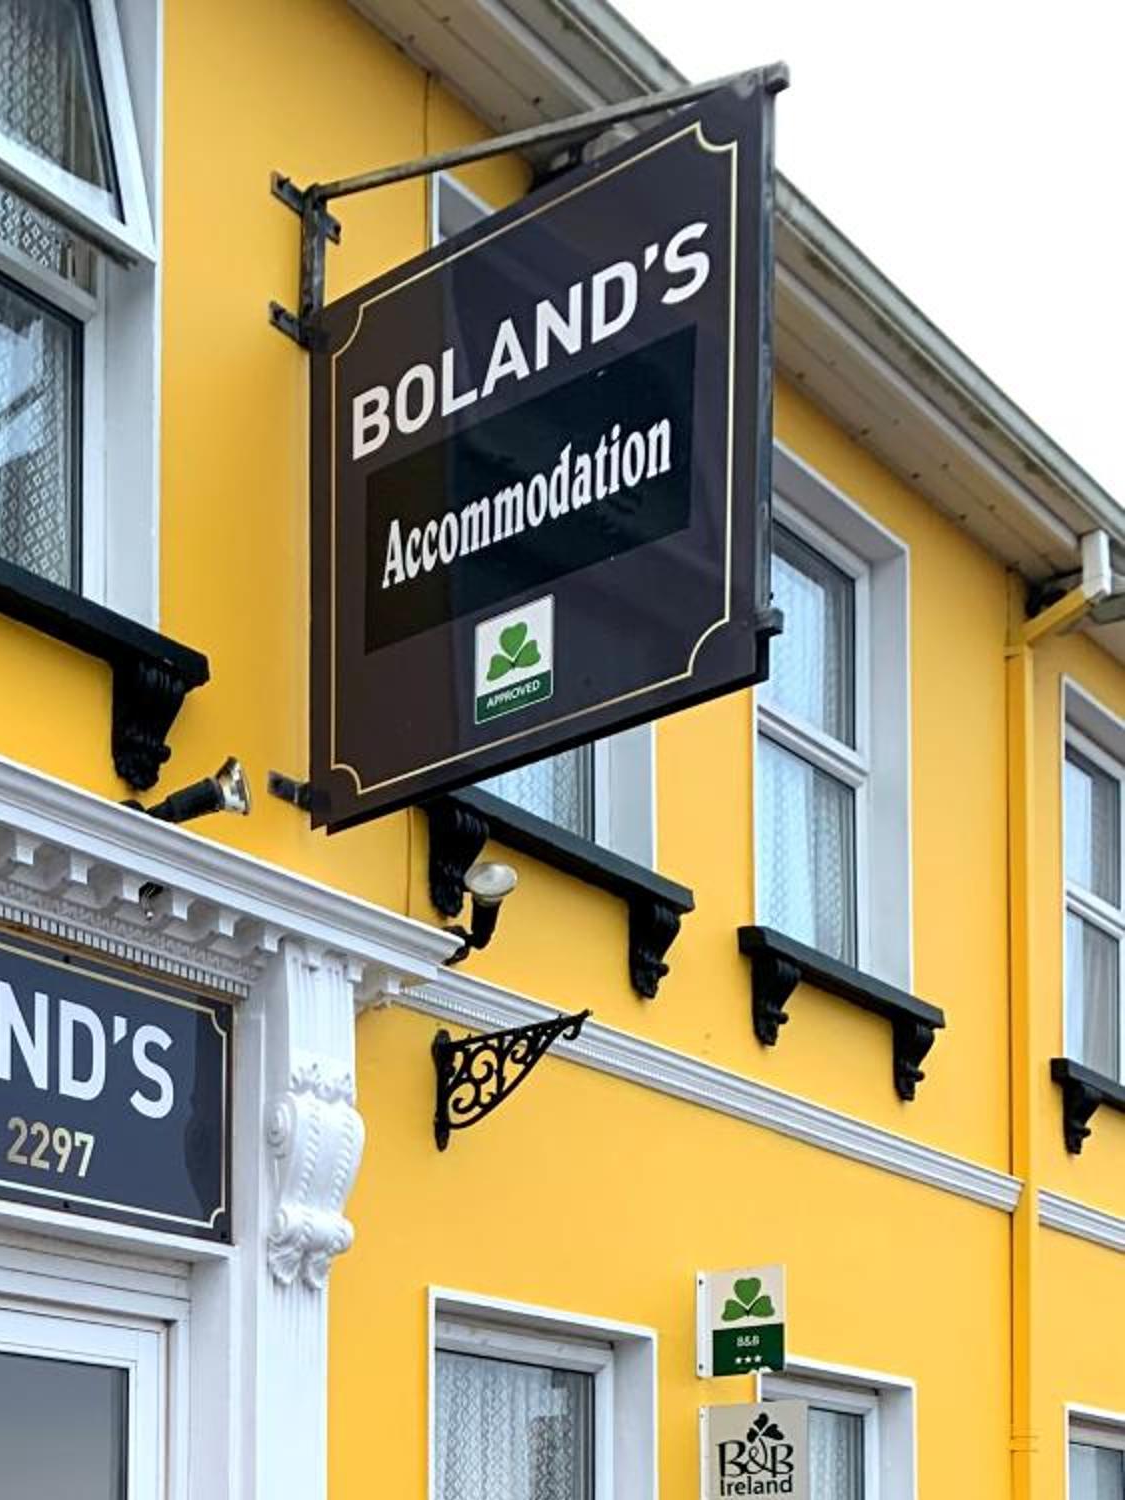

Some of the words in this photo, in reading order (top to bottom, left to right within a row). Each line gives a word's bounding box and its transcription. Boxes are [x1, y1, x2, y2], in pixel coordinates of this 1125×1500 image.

[352, 222, 710, 460] BOLAND'S
[382, 418, 671, 588] Accommodation
[486, 680, 540, 709] APPROVED
[7, 1117, 95, 1177] 2297
[717, 1438, 794, 1478] B&B
[720, 1474, 793, 1496] Ireland
